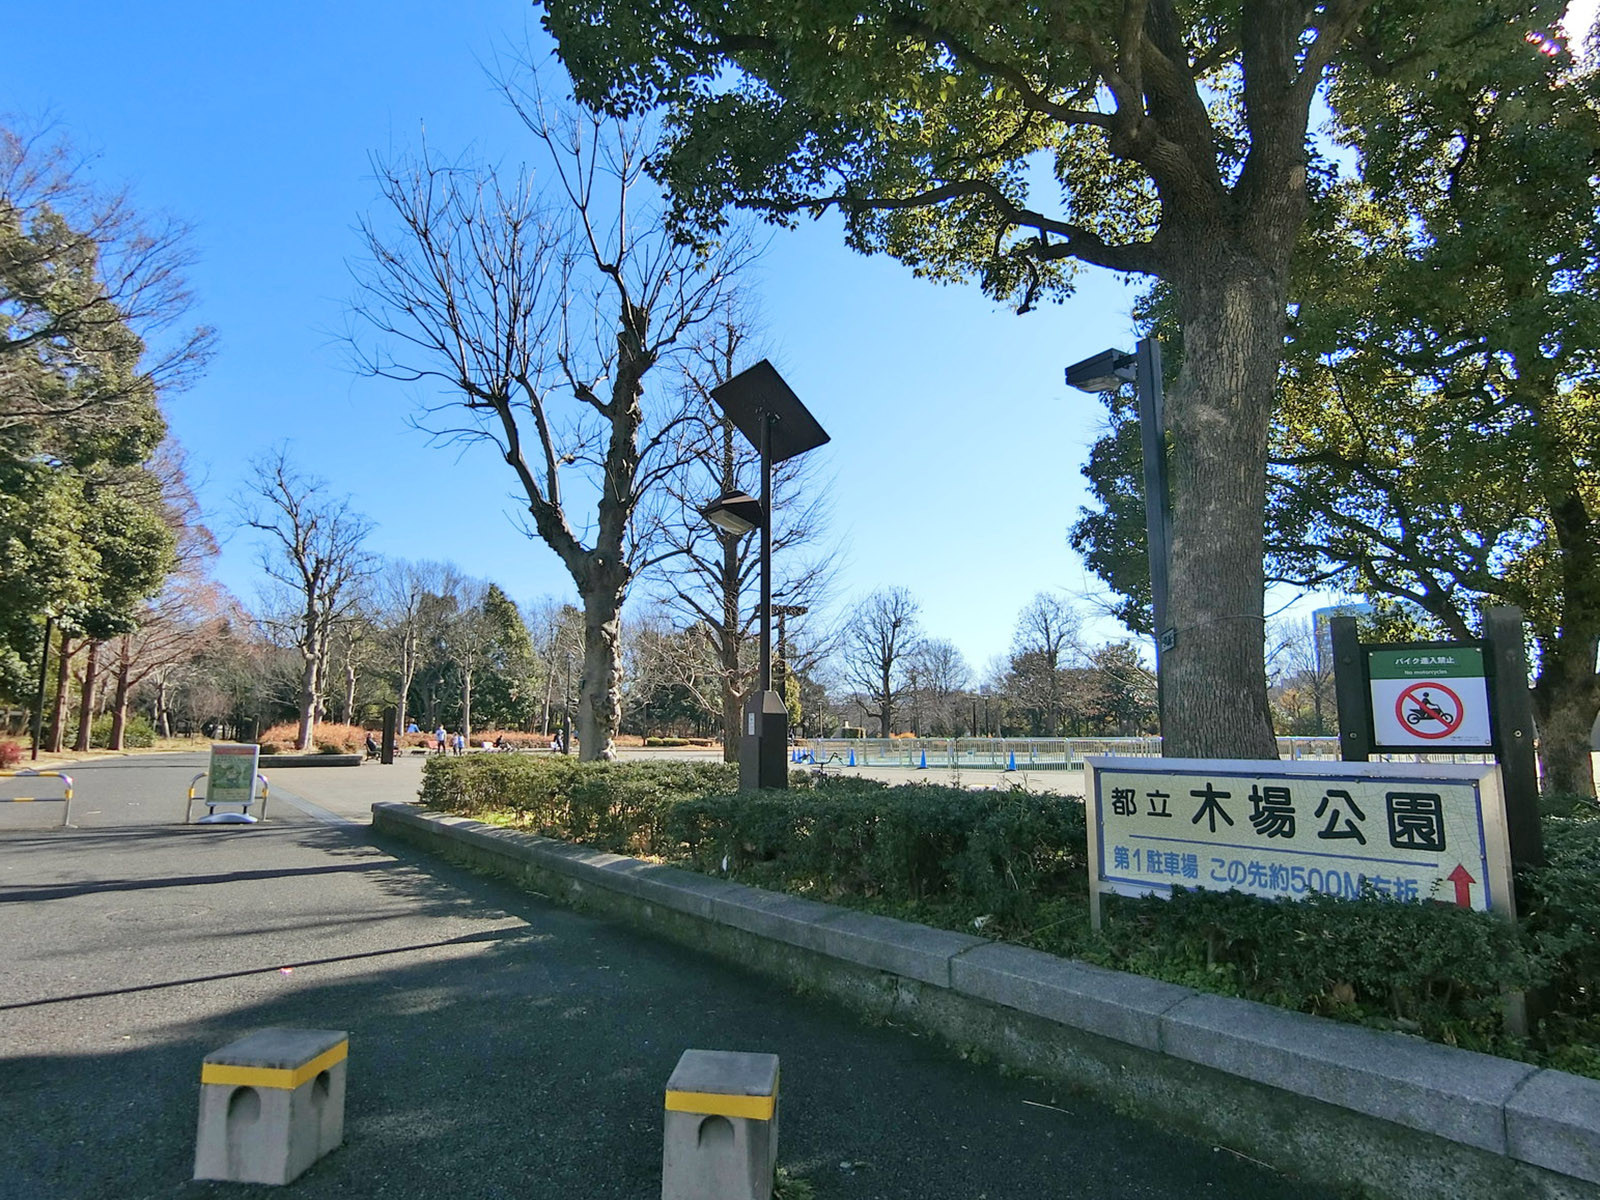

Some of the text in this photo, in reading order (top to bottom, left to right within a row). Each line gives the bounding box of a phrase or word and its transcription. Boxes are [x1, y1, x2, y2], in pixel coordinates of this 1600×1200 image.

[1395, 656, 1456, 665] バイク進入禁止
[1111, 782, 1446, 852] 都立木場公園
[1113, 845, 1199, 879] 第1駐車場
